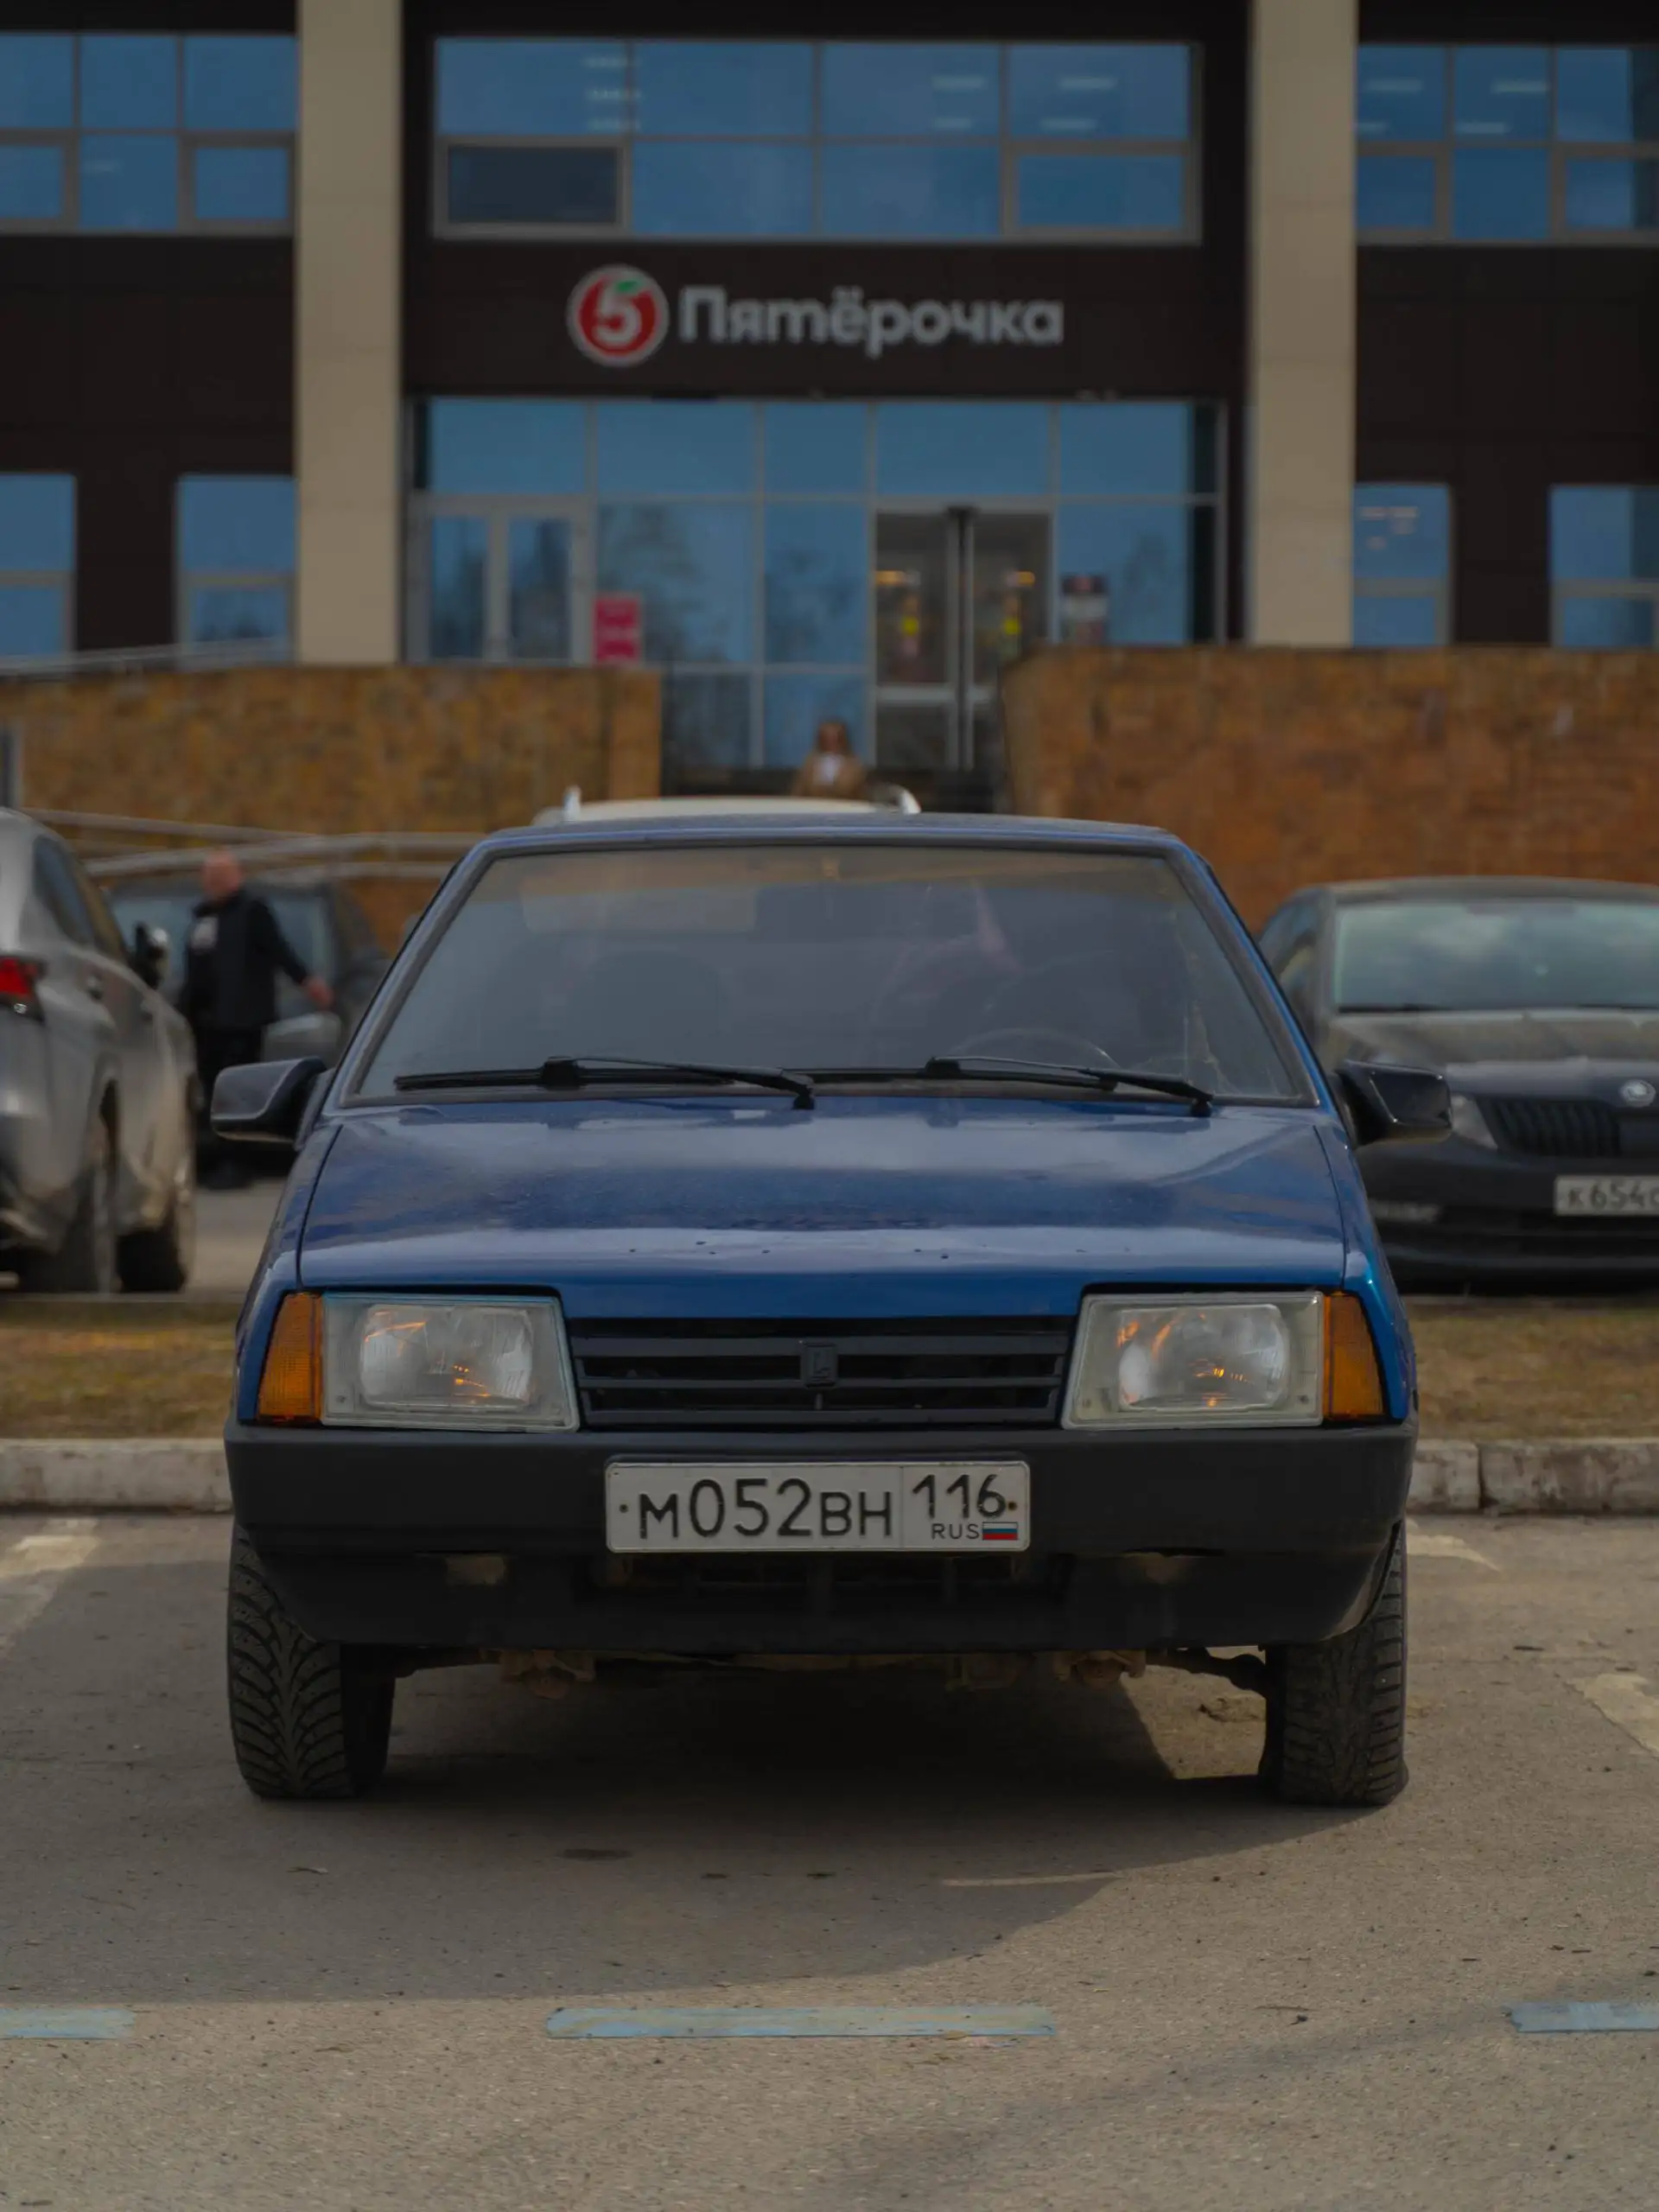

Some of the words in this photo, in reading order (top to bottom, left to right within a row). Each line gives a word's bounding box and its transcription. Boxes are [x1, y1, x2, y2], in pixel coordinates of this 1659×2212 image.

[679, 285, 1065, 359] Пятёрочка
[912, 1474, 1007, 1519] 116
[931, 1523, 981, 1540] RUS
